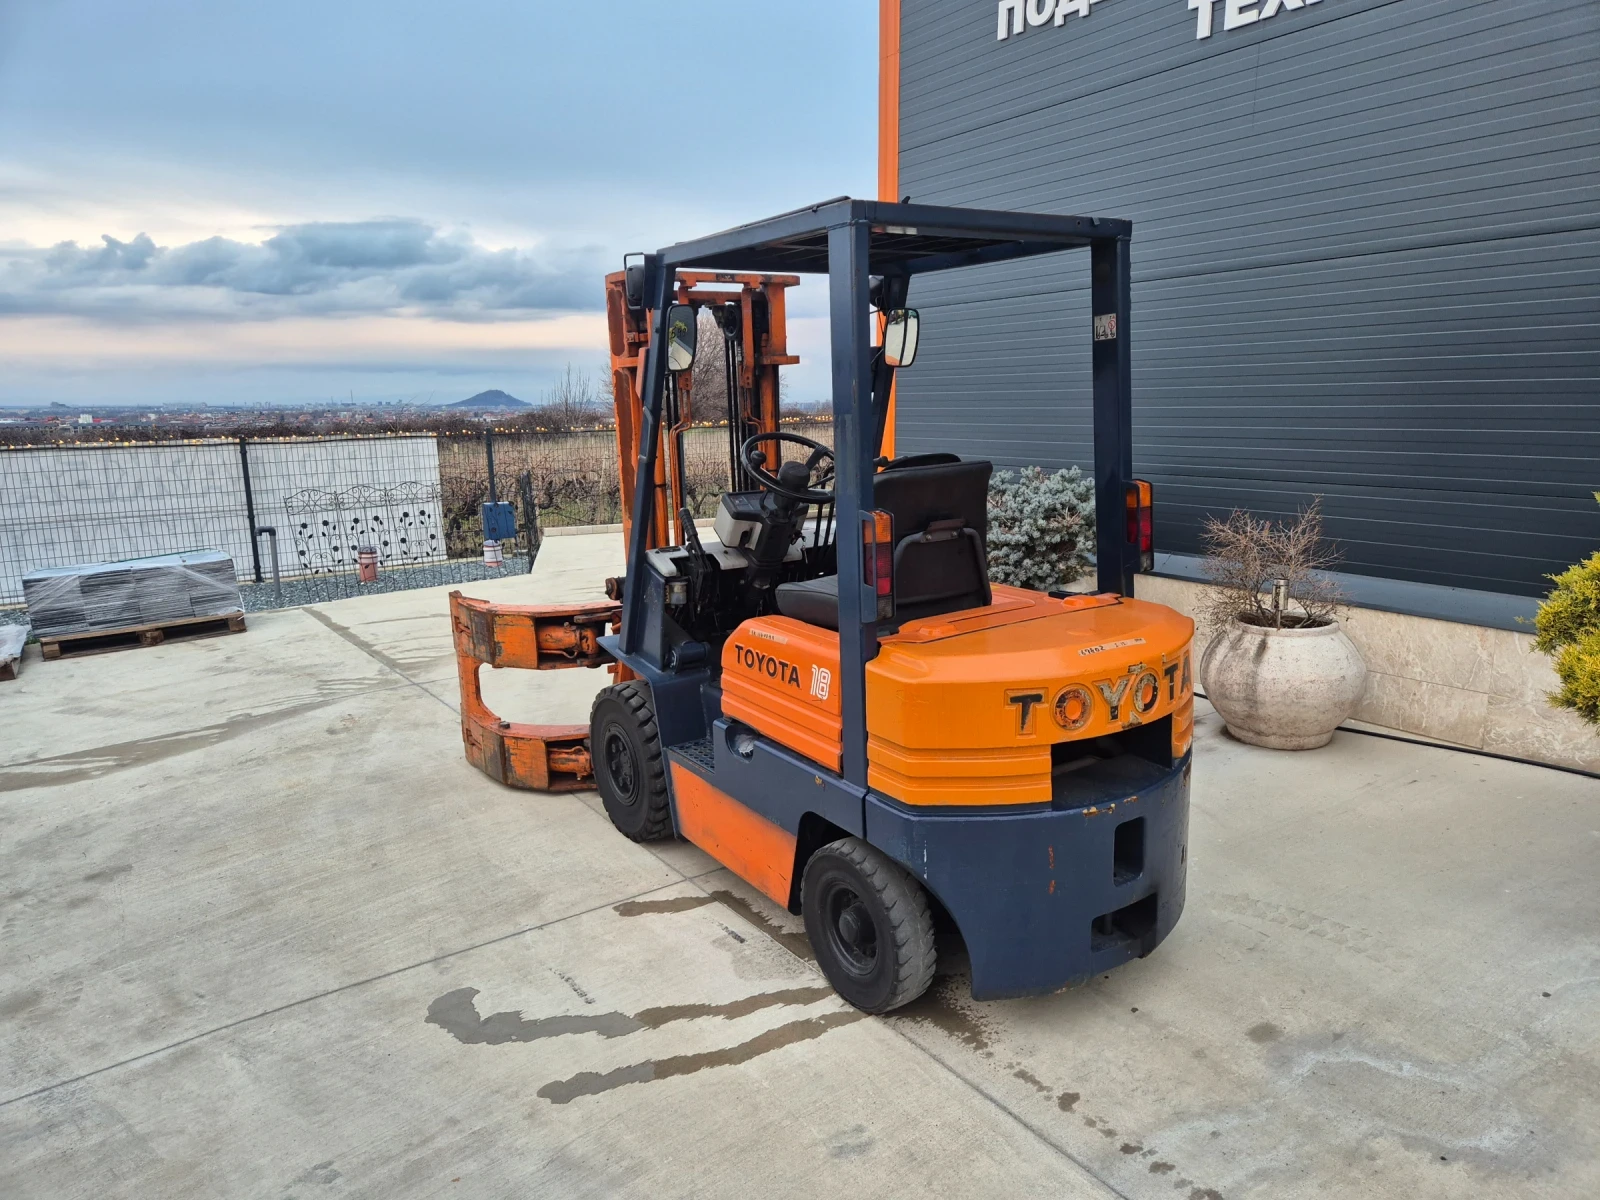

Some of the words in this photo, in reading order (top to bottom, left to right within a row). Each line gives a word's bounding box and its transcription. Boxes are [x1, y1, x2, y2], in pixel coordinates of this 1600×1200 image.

[734, 643, 801, 689] TOYOTA
[810, 663, 831, 700] 18
[1007, 651, 1192, 735] TOYOTA
